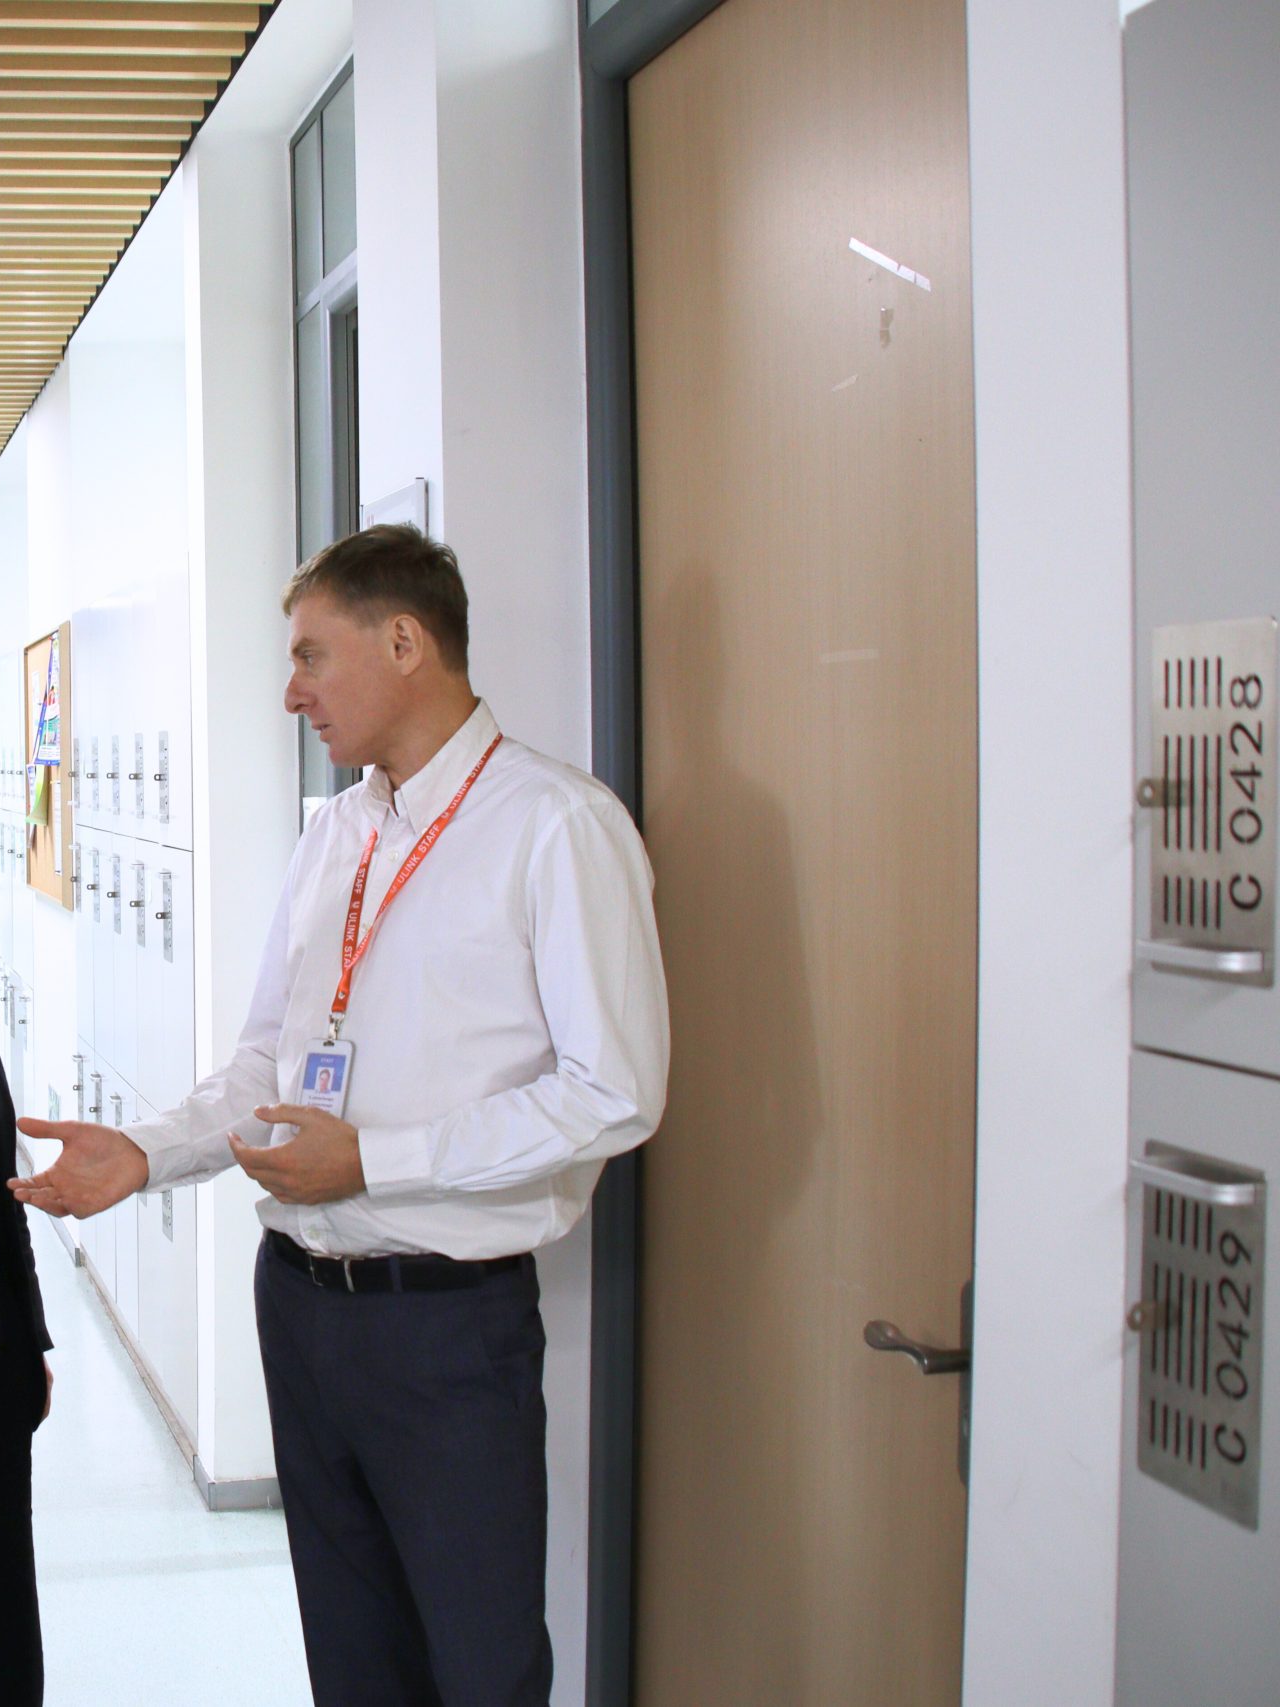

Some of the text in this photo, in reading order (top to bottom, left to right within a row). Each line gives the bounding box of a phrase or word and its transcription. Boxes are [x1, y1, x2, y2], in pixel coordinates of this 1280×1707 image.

[1229, 672, 1263, 912] C 0428
[397, 823, 441, 884] ULINK STAFF
[354, 867, 366, 895] STAFF
[345, 912, 358, 942] ULINK
[343, 945, 353, 968] STA
[1215, 1231, 1252, 1465] C 0429
